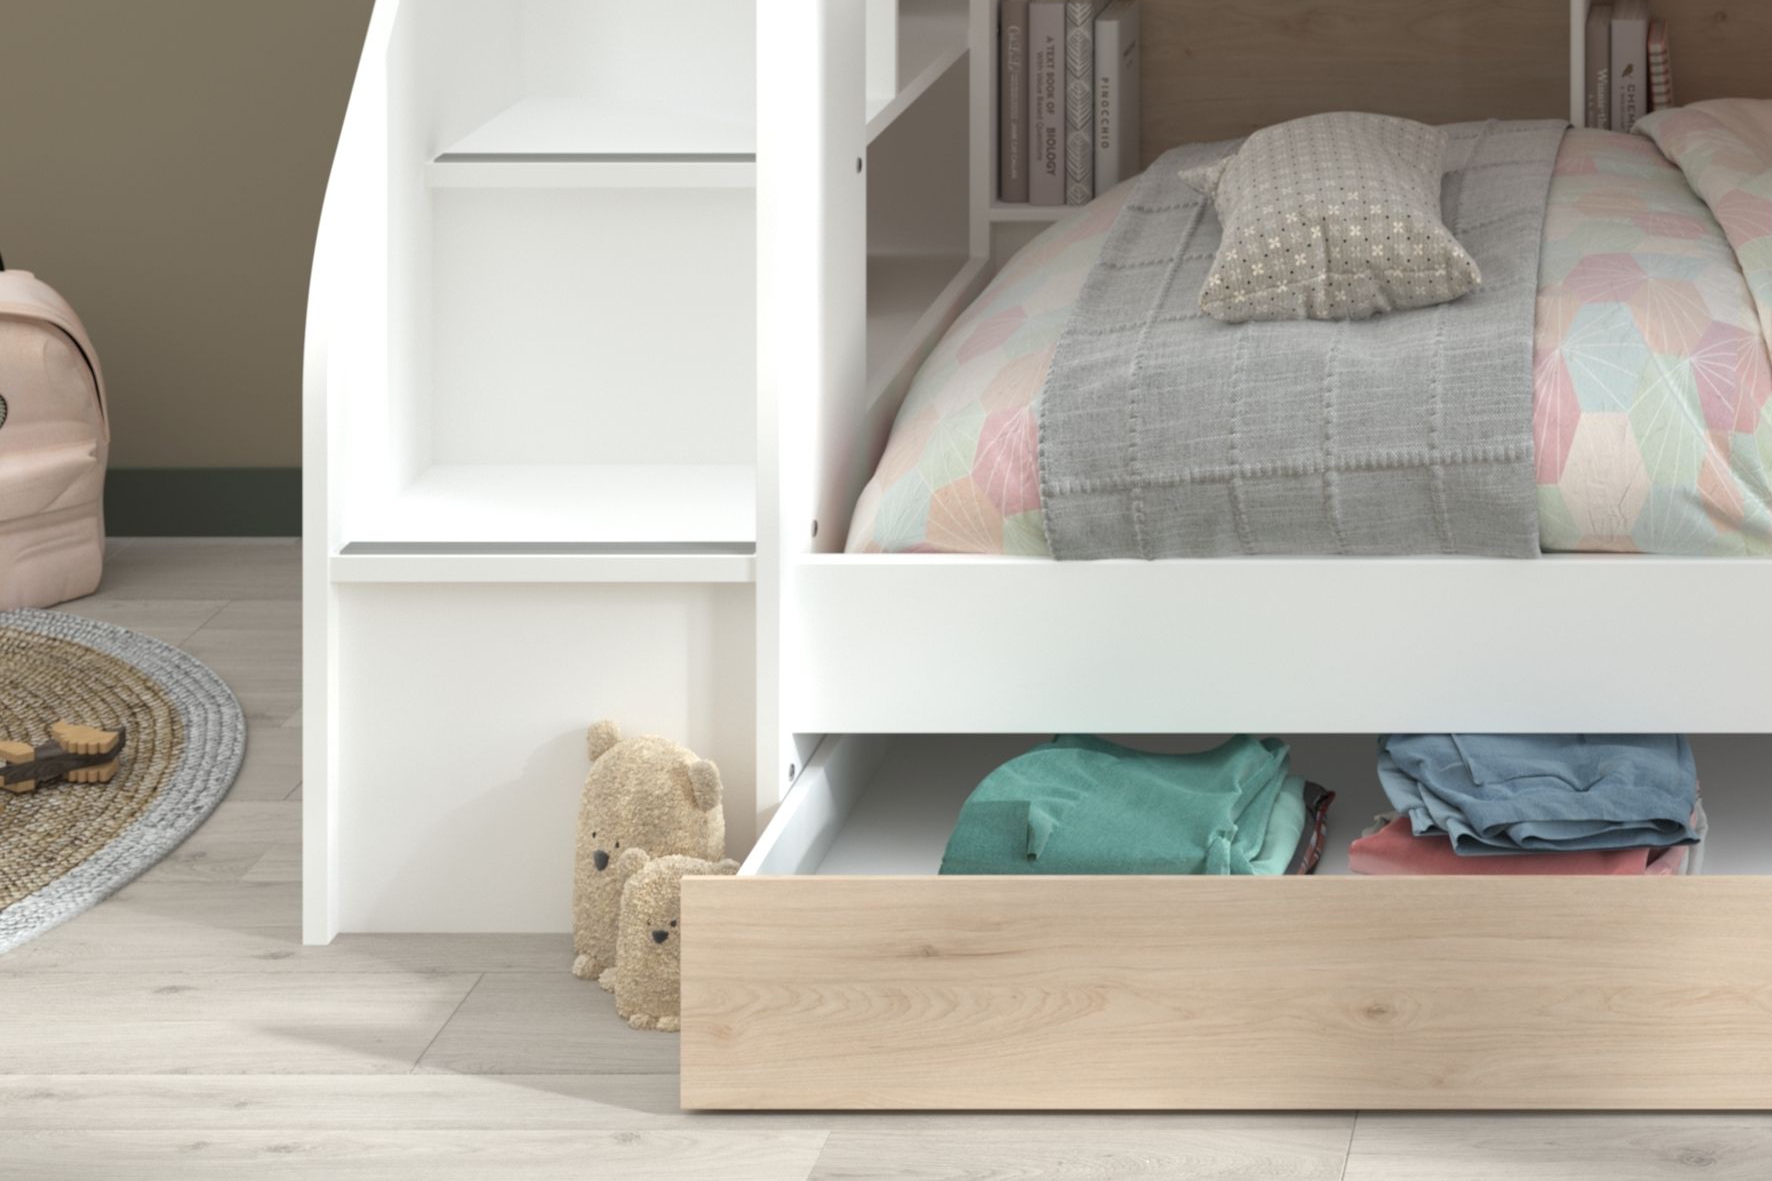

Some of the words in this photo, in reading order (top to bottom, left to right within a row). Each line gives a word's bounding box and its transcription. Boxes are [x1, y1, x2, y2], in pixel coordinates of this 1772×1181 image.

[1036, 52, 1044, 70] With
[1046, 45, 1055, 68] TEXT
[1036, 73, 1044, 94] Value
[1046, 72, 1055, 98] BOOK
[1036, 96, 1044, 119] Based
[1046, 102, 1055, 115] OF
[1100, 77, 1110, 149] PINOCCHIO
[1046, 126, 1057, 176] BIOLOGY
